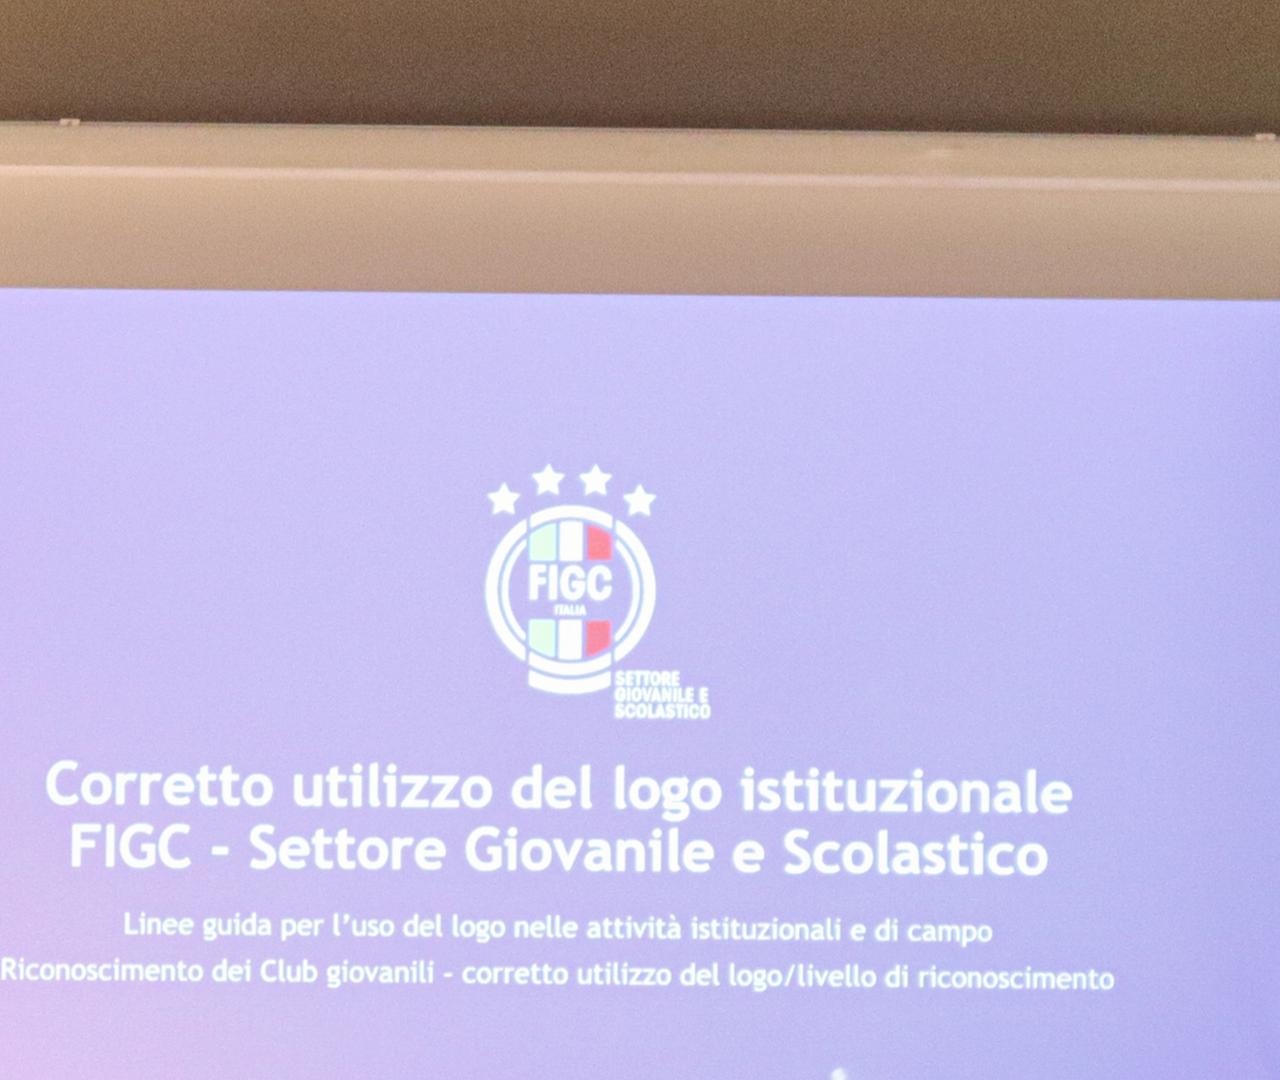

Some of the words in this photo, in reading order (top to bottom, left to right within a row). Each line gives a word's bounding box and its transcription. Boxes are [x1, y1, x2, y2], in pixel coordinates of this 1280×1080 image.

[529, 564, 613, 601] FIGC
[554, 604, 587, 616] ITALIA
[614, 670, 681, 686] SETTORE
[614, 686, 695, 703] GIOVANILE
[699, 688, 709, 703] E
[614, 703, 712, 719] SCOLASTICO
[46, 760, 273, 806] Corretto
[294, 762, 492, 808] utilizzo
[511, 764, 592, 809] del
[615, 764, 722, 822] logo
[740, 766, 1072, 814] istituzionale
[72, 824, 191, 869] FIGC
[250, 824, 446, 870] Settore
[465, 824, 714, 873] Giovanile
[732, 840, 764, 873] e
[784, 829, 1048, 876] Scolastico
[124, 912, 194, 935] Linee
[203, 912, 272, 941] guida
[281, 918, 324, 941] per
[333, 913, 395, 937] l’uso
[403, 913, 442, 937] del
[452, 914, 506, 943] logo
[514, 915, 578, 938] nelle
[587, 914, 681, 939] attività
[691, 916, 841, 940] istituzionali
[850, 924, 866, 941] e
[875, 918, 898, 941] di
[907, 924, 992, 947] campo
[1, 957, 204, 981] Riconoscimento
[212, 958, 251, 982] dei
[260, 959, 318, 983] Club
[327, 960, 434, 988] giovanili
[462, 964, 568, 984] corretto
[577, 962, 672, 985] utilizzo
[680, 963, 720, 986] del
[729, 963, 877, 992] logo/livello
[884, 965, 908, 988] di
[918, 965, 1114, 990] riconoscimento
